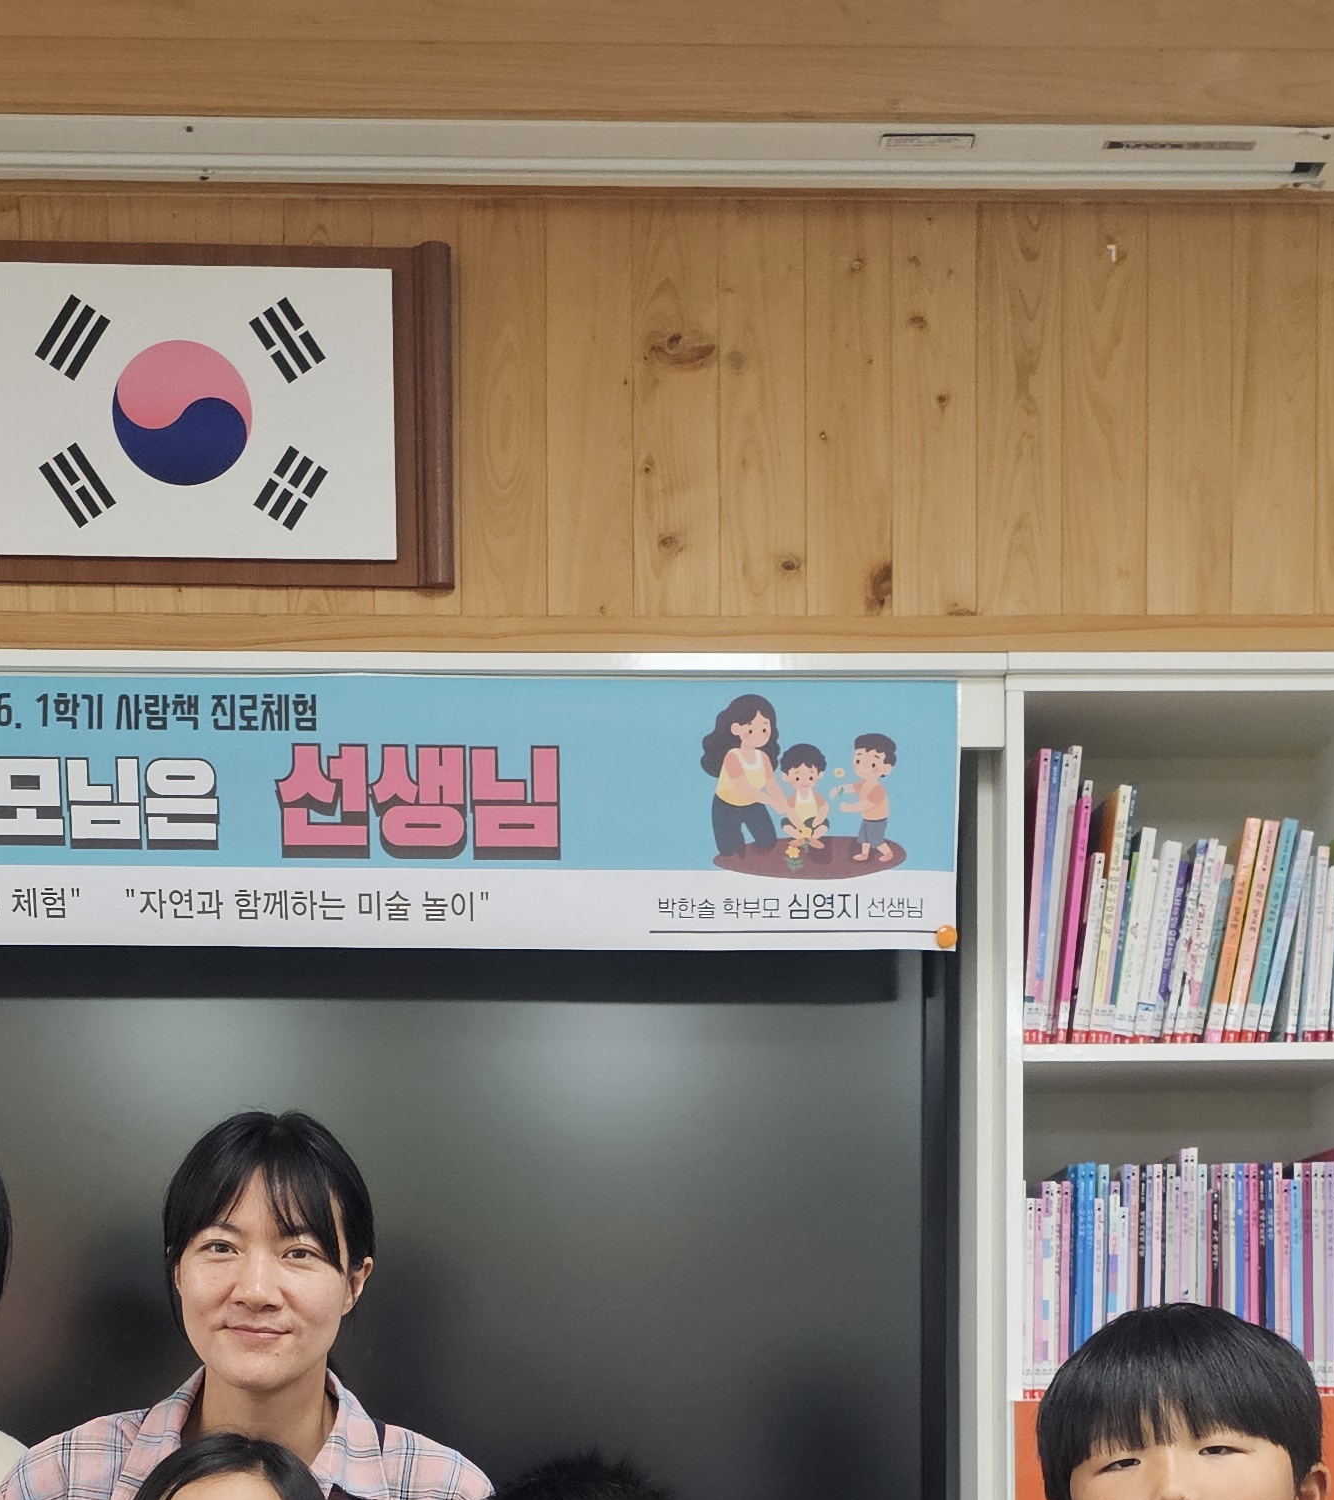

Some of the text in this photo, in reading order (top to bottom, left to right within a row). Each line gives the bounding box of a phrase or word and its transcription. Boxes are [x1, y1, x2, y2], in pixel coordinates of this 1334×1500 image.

[36, 692, 103, 730] 1학기
[116, 693, 199, 731] 사람책
[211, 693, 317, 732] 진로체험
[275, 743, 561, 861] 선생님
[12, 887, 81, 919] 체험"
[125, 888, 489, 922] "자연과 함께하는 미술 놀이"
[658, 893, 924, 920] 박한솔 학부모 심영지 선생님
